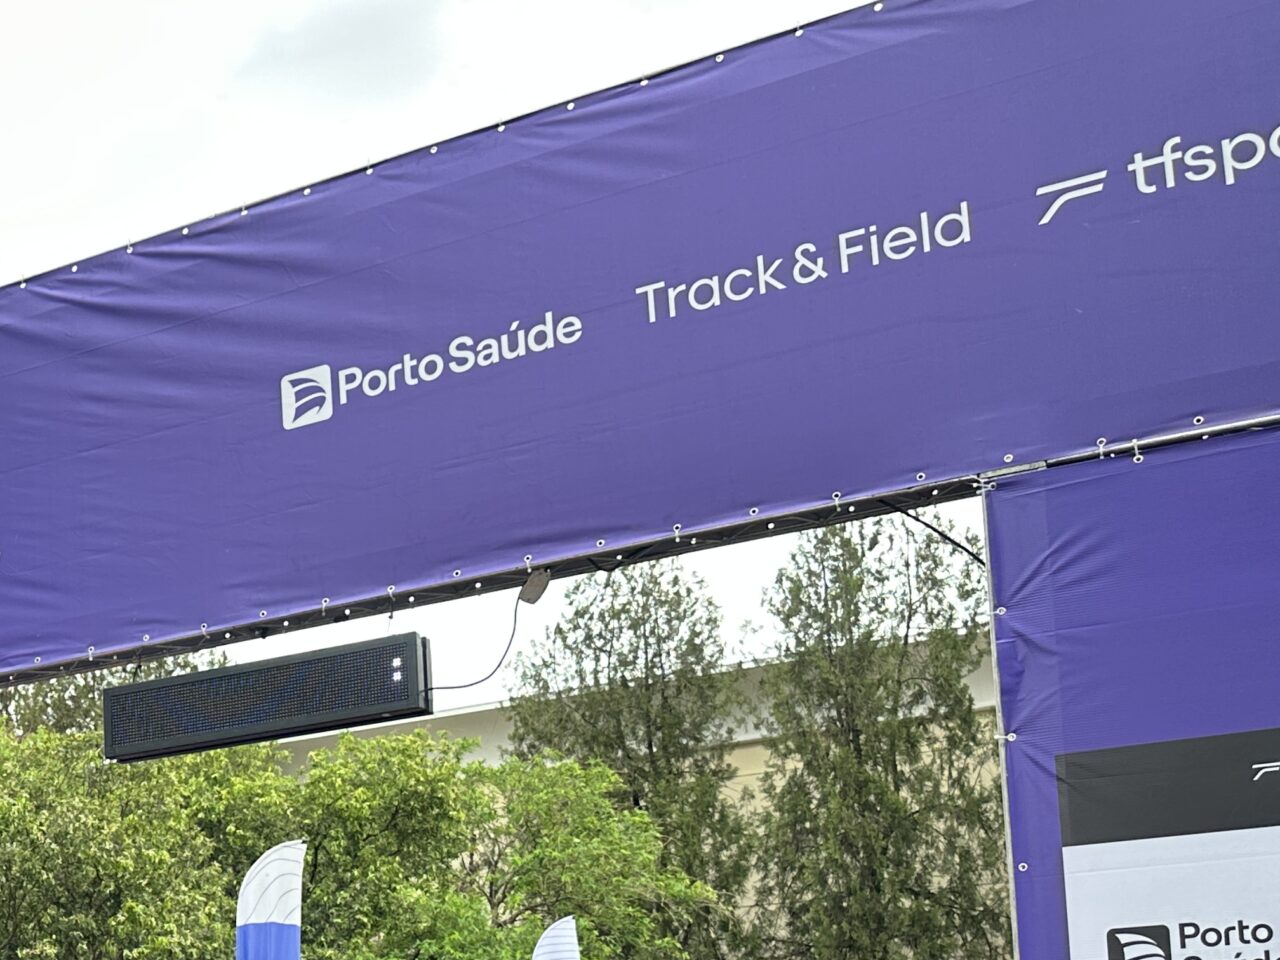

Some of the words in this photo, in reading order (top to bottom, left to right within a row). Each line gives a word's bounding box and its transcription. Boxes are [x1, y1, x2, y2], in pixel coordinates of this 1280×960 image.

[636, 251, 787, 324] Track
[792, 243, 830, 284] &
[837, 202, 972, 275] Field
[337, 351, 444, 406] Porto
[448, 309, 584, 376] Saúde
[1179, 920, 1273, 949] Porto
